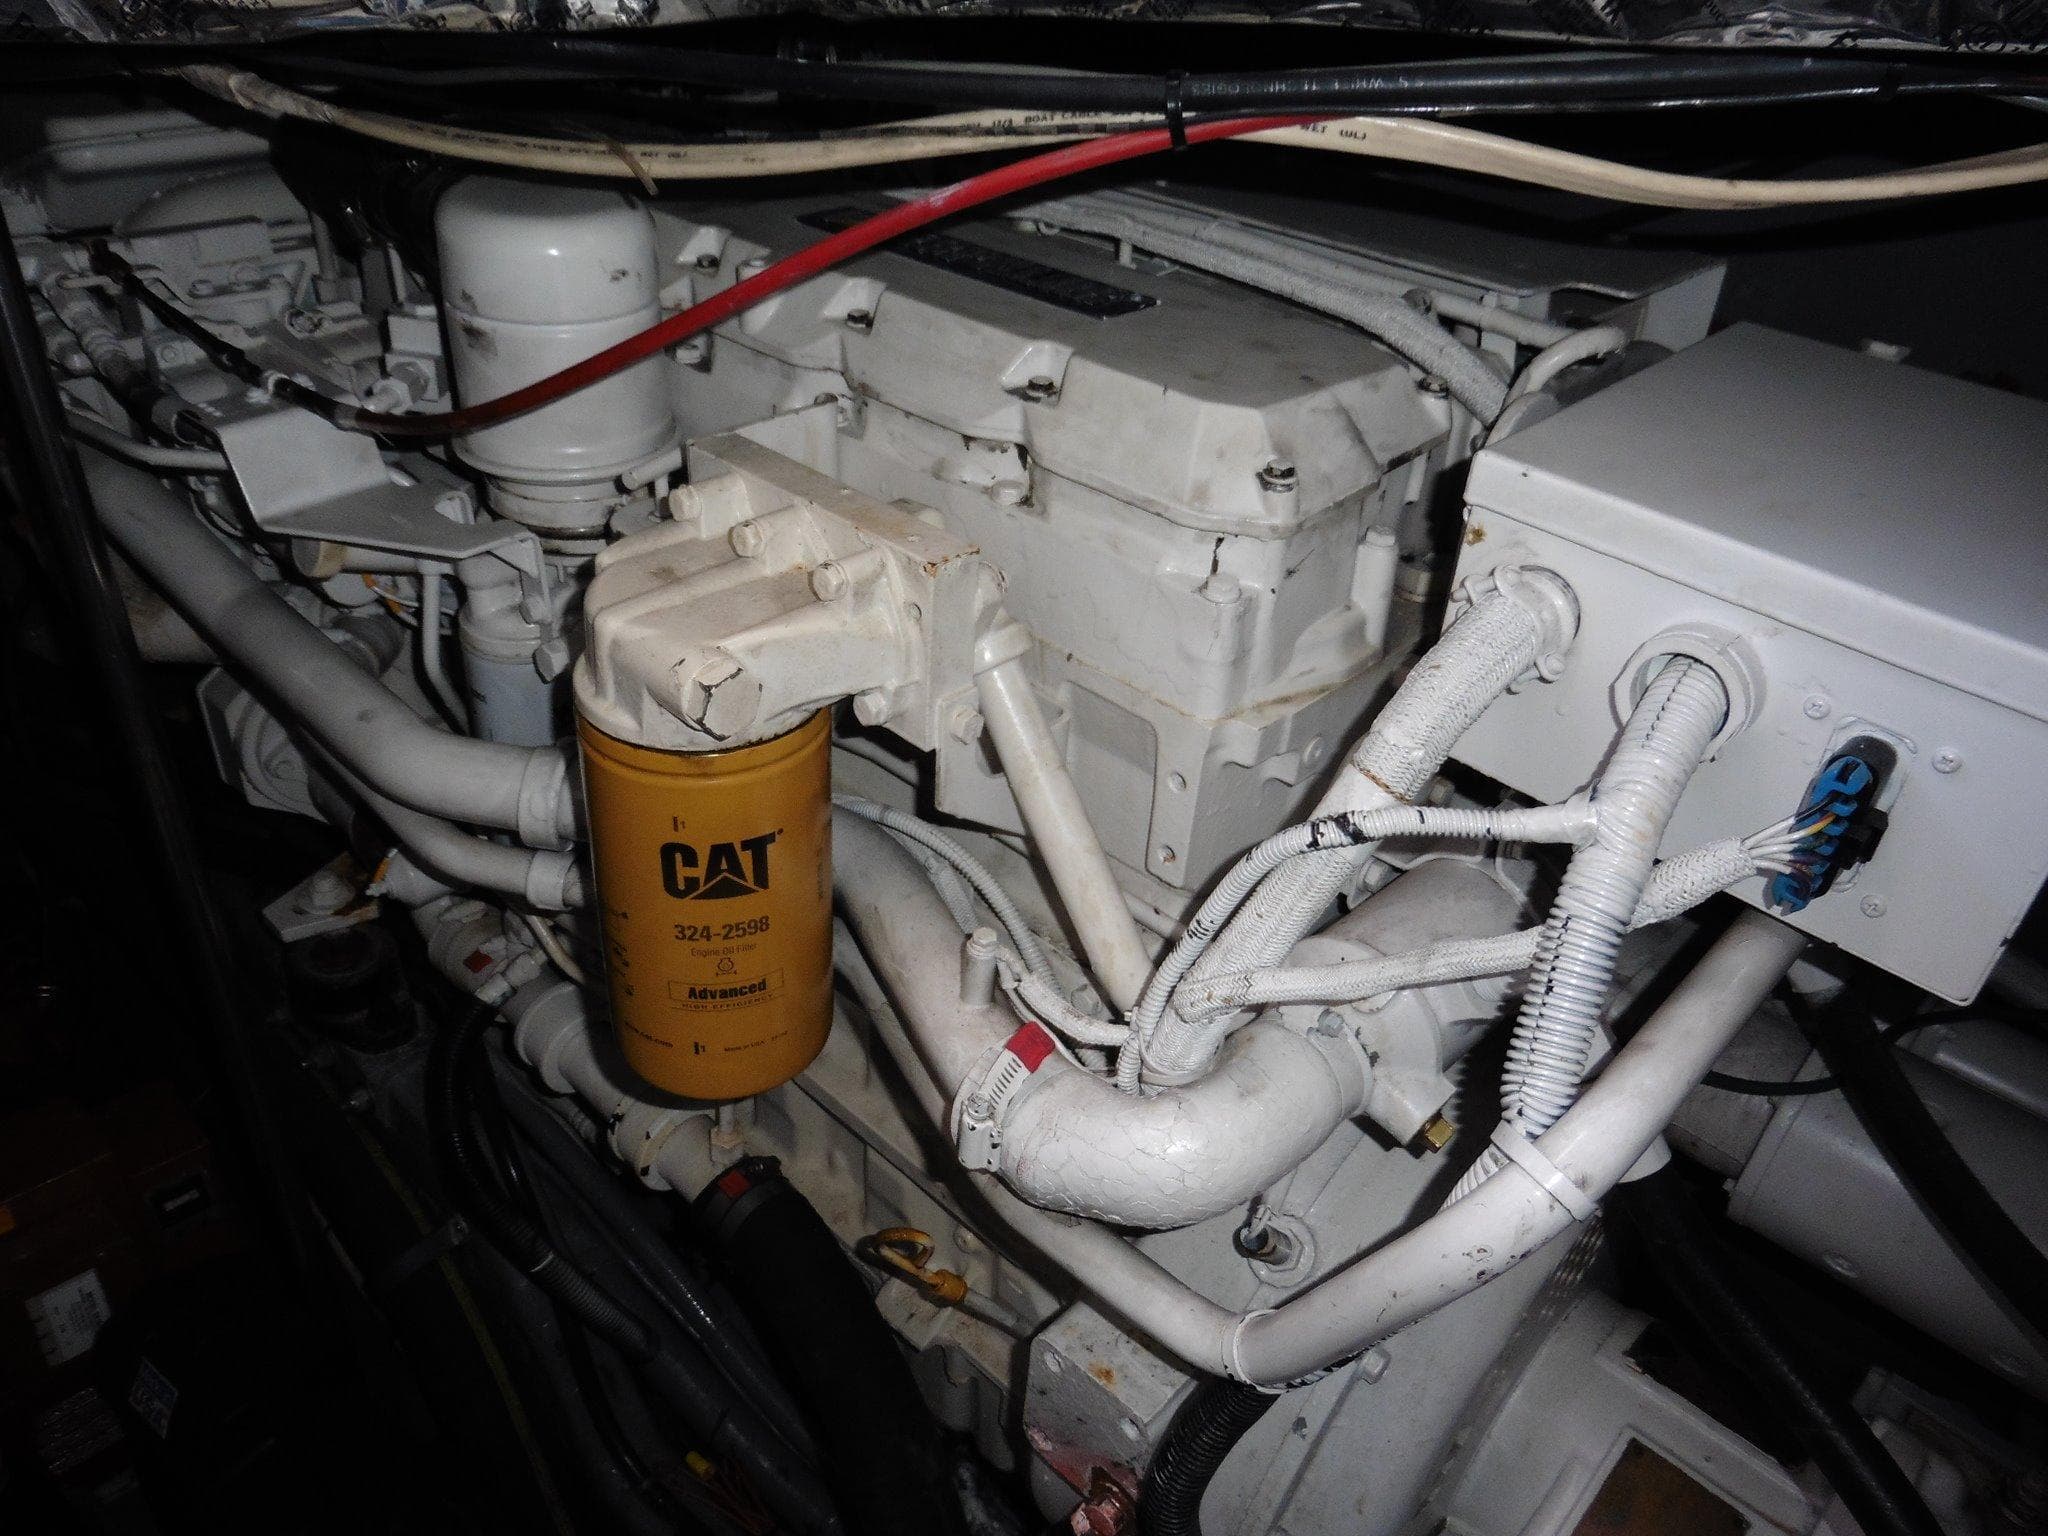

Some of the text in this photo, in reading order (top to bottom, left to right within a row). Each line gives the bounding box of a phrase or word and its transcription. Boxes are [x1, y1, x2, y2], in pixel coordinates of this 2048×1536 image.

[659, 832, 778, 900] CAT
[674, 915, 770, 941] 324-2598
[690, 947, 720, 957] Engine
[737, 943, 758, 953] Filter
[688, 978, 767, 1000] Advanced
